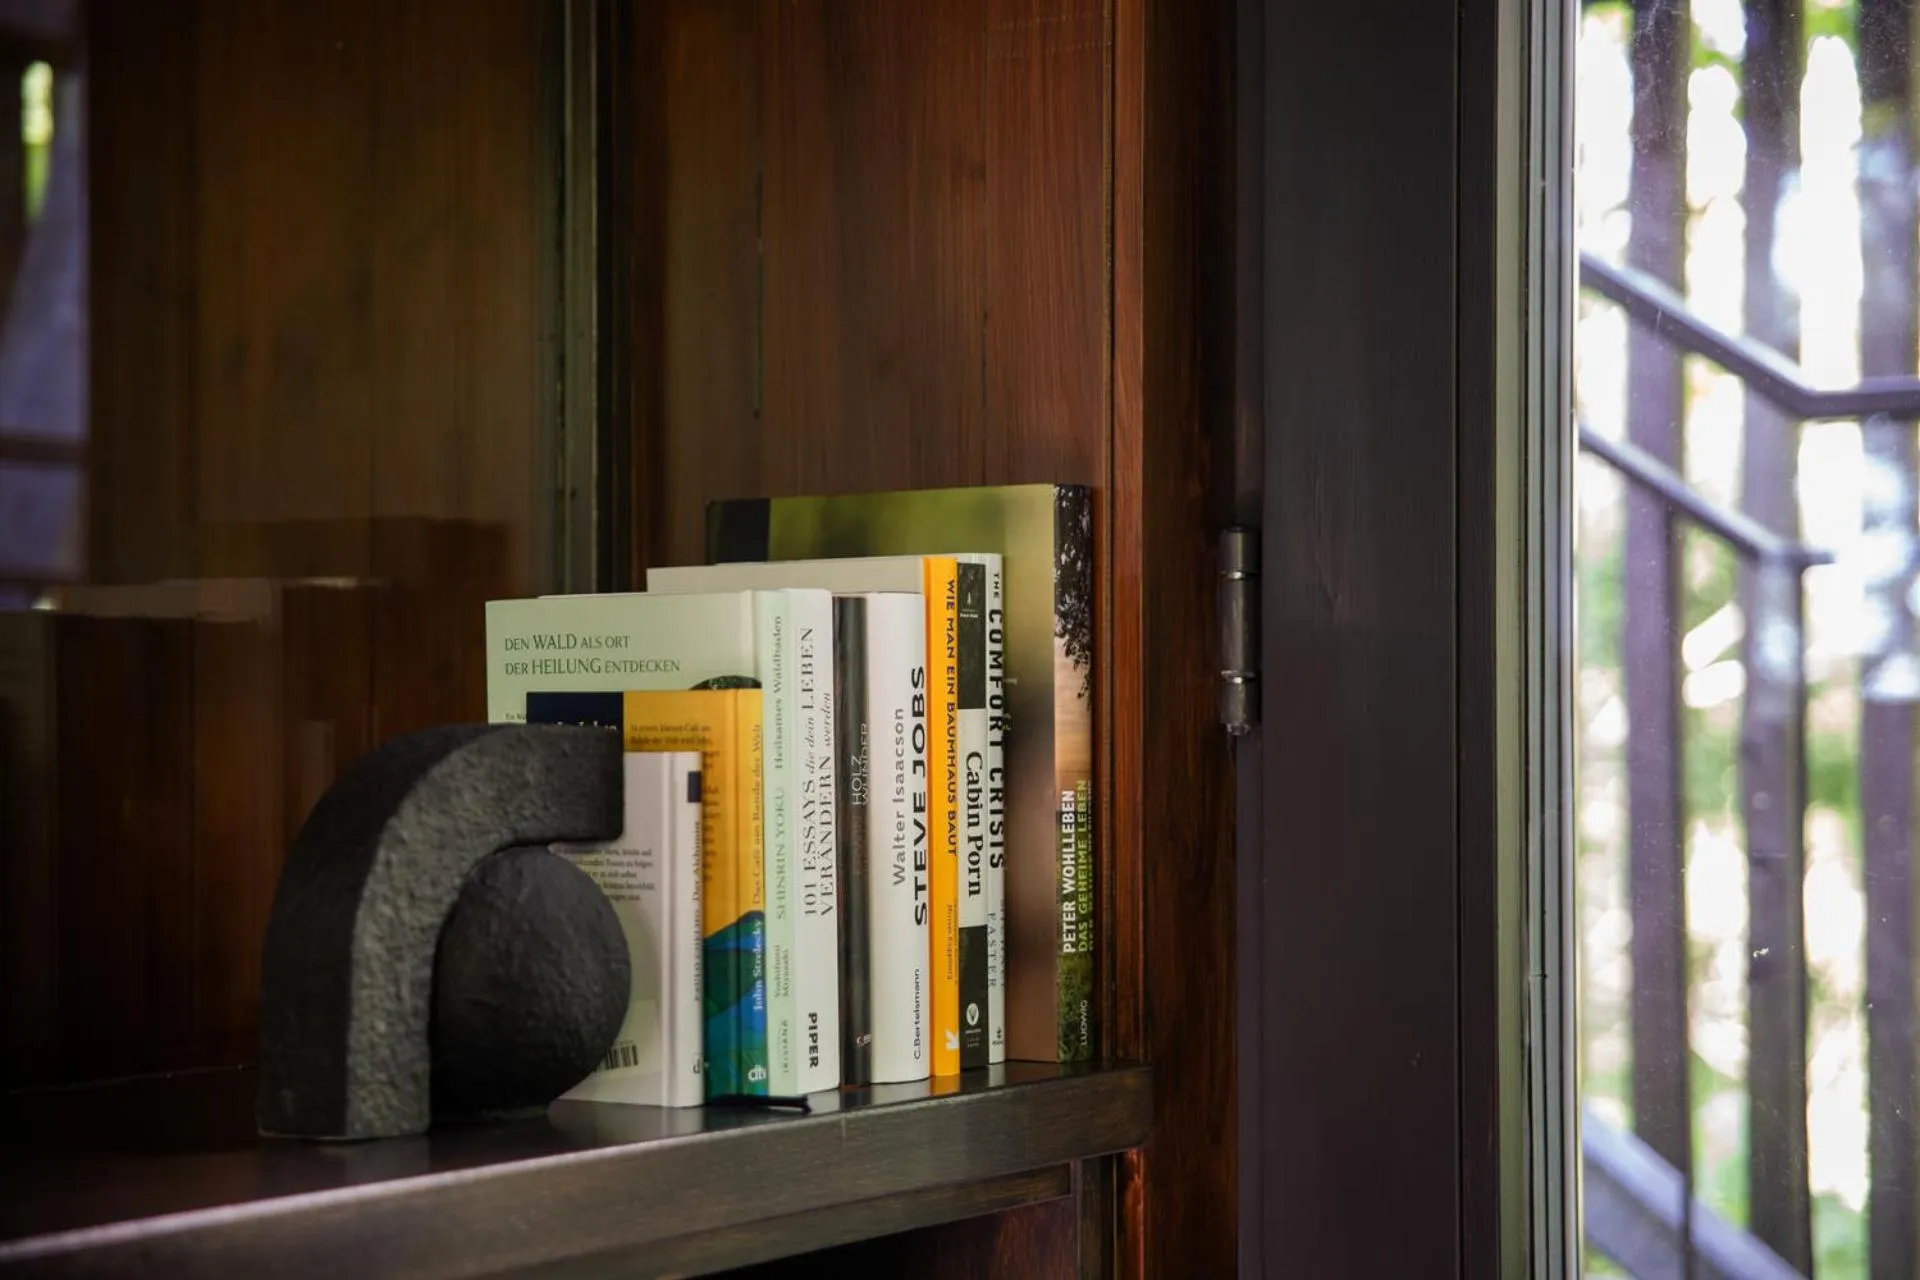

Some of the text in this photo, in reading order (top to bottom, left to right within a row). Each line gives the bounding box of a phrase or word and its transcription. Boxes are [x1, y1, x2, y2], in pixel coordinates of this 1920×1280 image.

[505, 633, 630, 651] DEN WALD ALS ORT
[505, 658, 680, 675] DER HEILUNG ENTDECKEN
[772, 616, 783, 769] Heilsames Waldbaden
[989, 609, 1003, 747] COMFORT
[800, 628, 817, 915] 101 ESSAYS die dein LEBEN
[851, 755, 862, 805] HOLZ
[946, 579, 958, 857] WIE MAN EIN BAUMHAUS BAUT
[775, 787, 786, 919] SHINRIN YOKU
[818, 692, 834, 915] VERÄNDERN werden
[892, 708, 906, 886] Walter Isaacson
[911, 666, 928, 926] STEVE JOBS
[966, 751, 984, 898] Cabin Porn
[989, 767, 1004, 869] CRISIS
[1077, 779, 1088, 952] DAS GEHEIME LEBEN
[1062, 790, 1076, 953] PETER WOHLLEBEN
[752, 919, 763, 1011] John Strelecky
[1080, 1000, 1088, 1046] LUDWIG
[808, 1012, 819, 1068] PIPER
